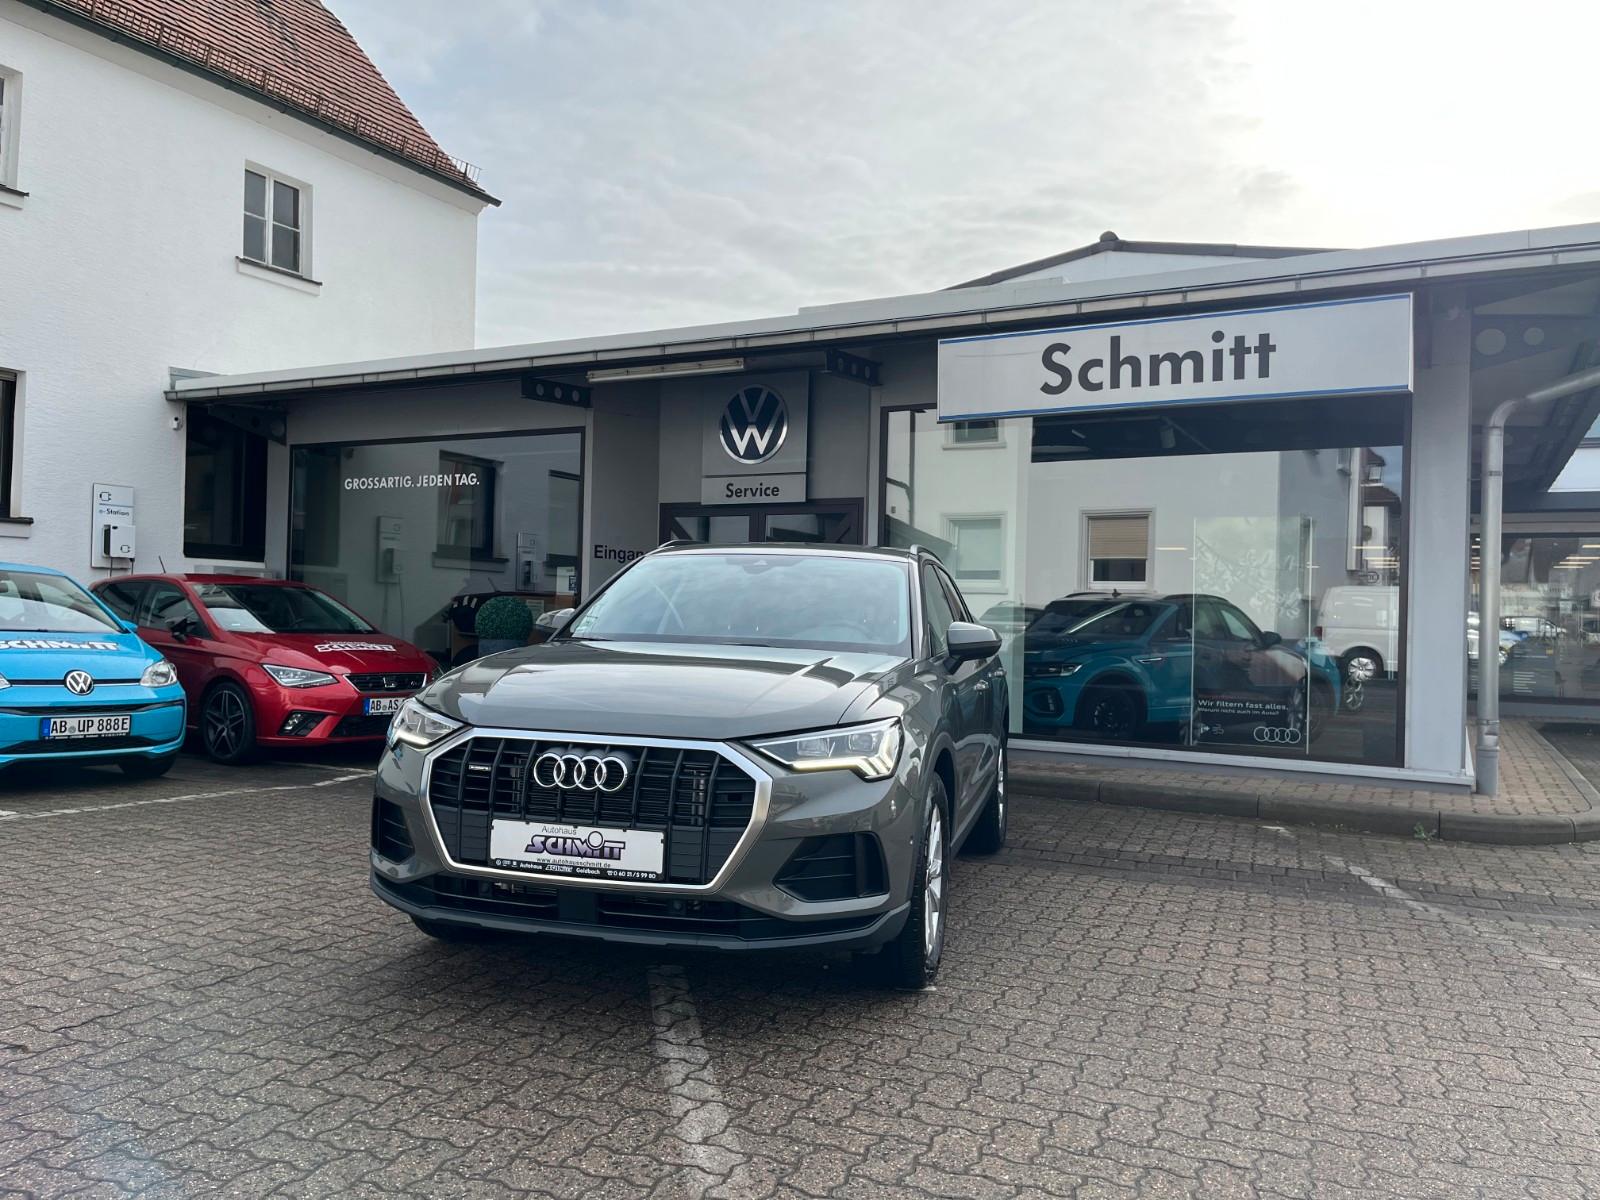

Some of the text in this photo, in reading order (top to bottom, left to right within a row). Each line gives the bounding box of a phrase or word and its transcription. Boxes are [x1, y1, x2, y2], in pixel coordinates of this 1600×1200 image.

[1040, 330, 1276, 395] Schmitt
[344, 472, 480, 489] GROSSARTIG. JEDEN TAG.
[725, 482, 780, 498] Service
[371, 699, 381, 711] AB
[388, 699, 399, 711] AS
[1198, 699, 1214, 707] Wir
[1216, 700, 1244, 709] filtern
[1265, 703, 1289, 711] alles.
[51, 717, 129, 734] AB UP 888E
[541, 825, 577, 835] Autohaus
[524, 830, 626, 861] SCHMITT
[519, 862, 542, 870] Autohaus
[536, 857, 611, 868] www.autohausschmitt.de
